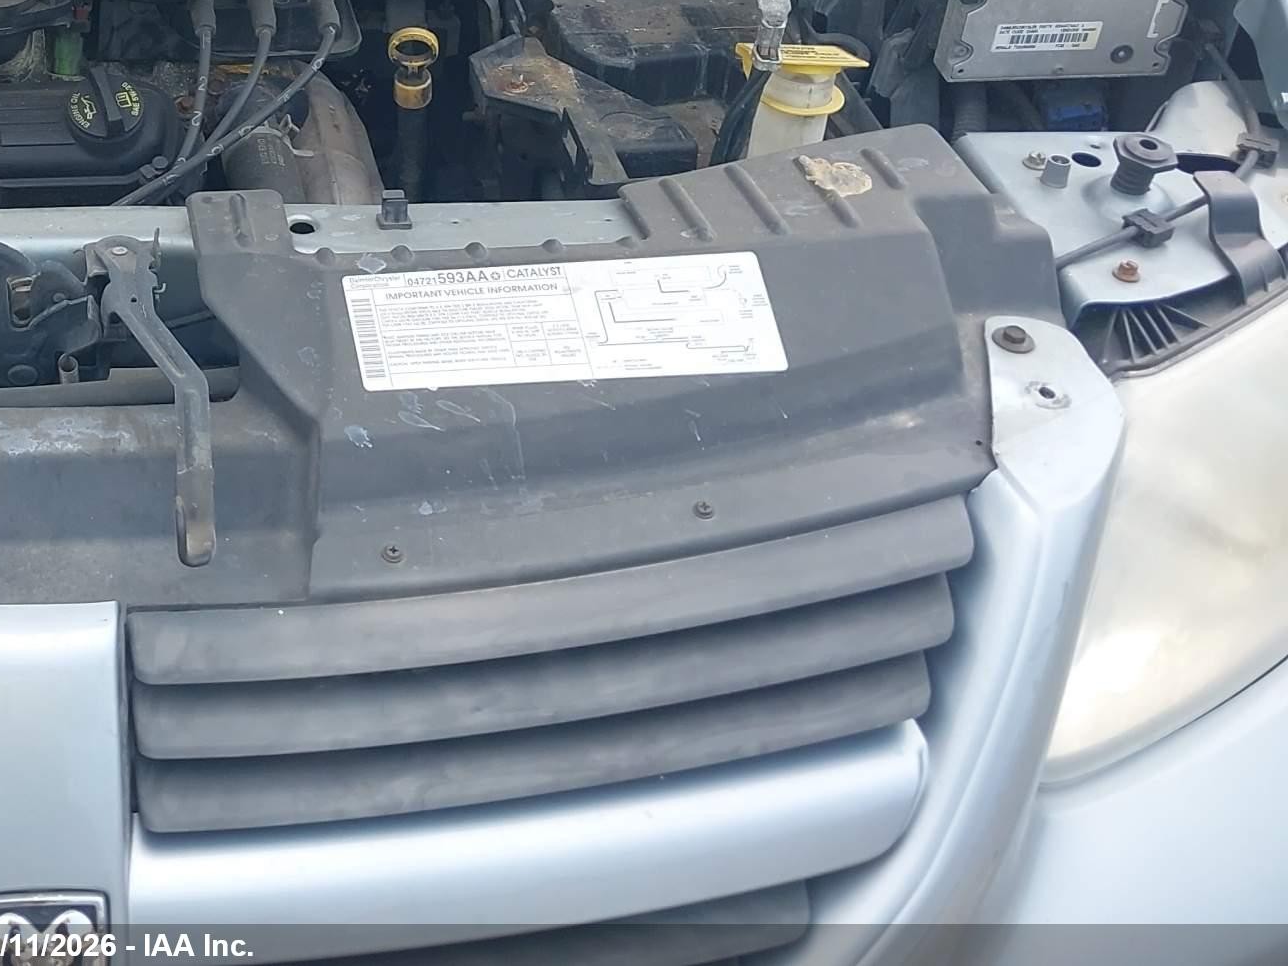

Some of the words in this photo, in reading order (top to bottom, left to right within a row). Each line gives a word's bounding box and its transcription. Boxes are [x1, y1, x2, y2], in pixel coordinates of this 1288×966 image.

[70, 92, 81, 104] OIL
[71, 104, 91, 129] ENGINE
[506, 266, 562, 279] CATALYST
[385, 290, 442, 301] IMPORTANT
[445, 287, 486, 297] VEHICLE
[487, 283, 558, 294] INFORMATION
